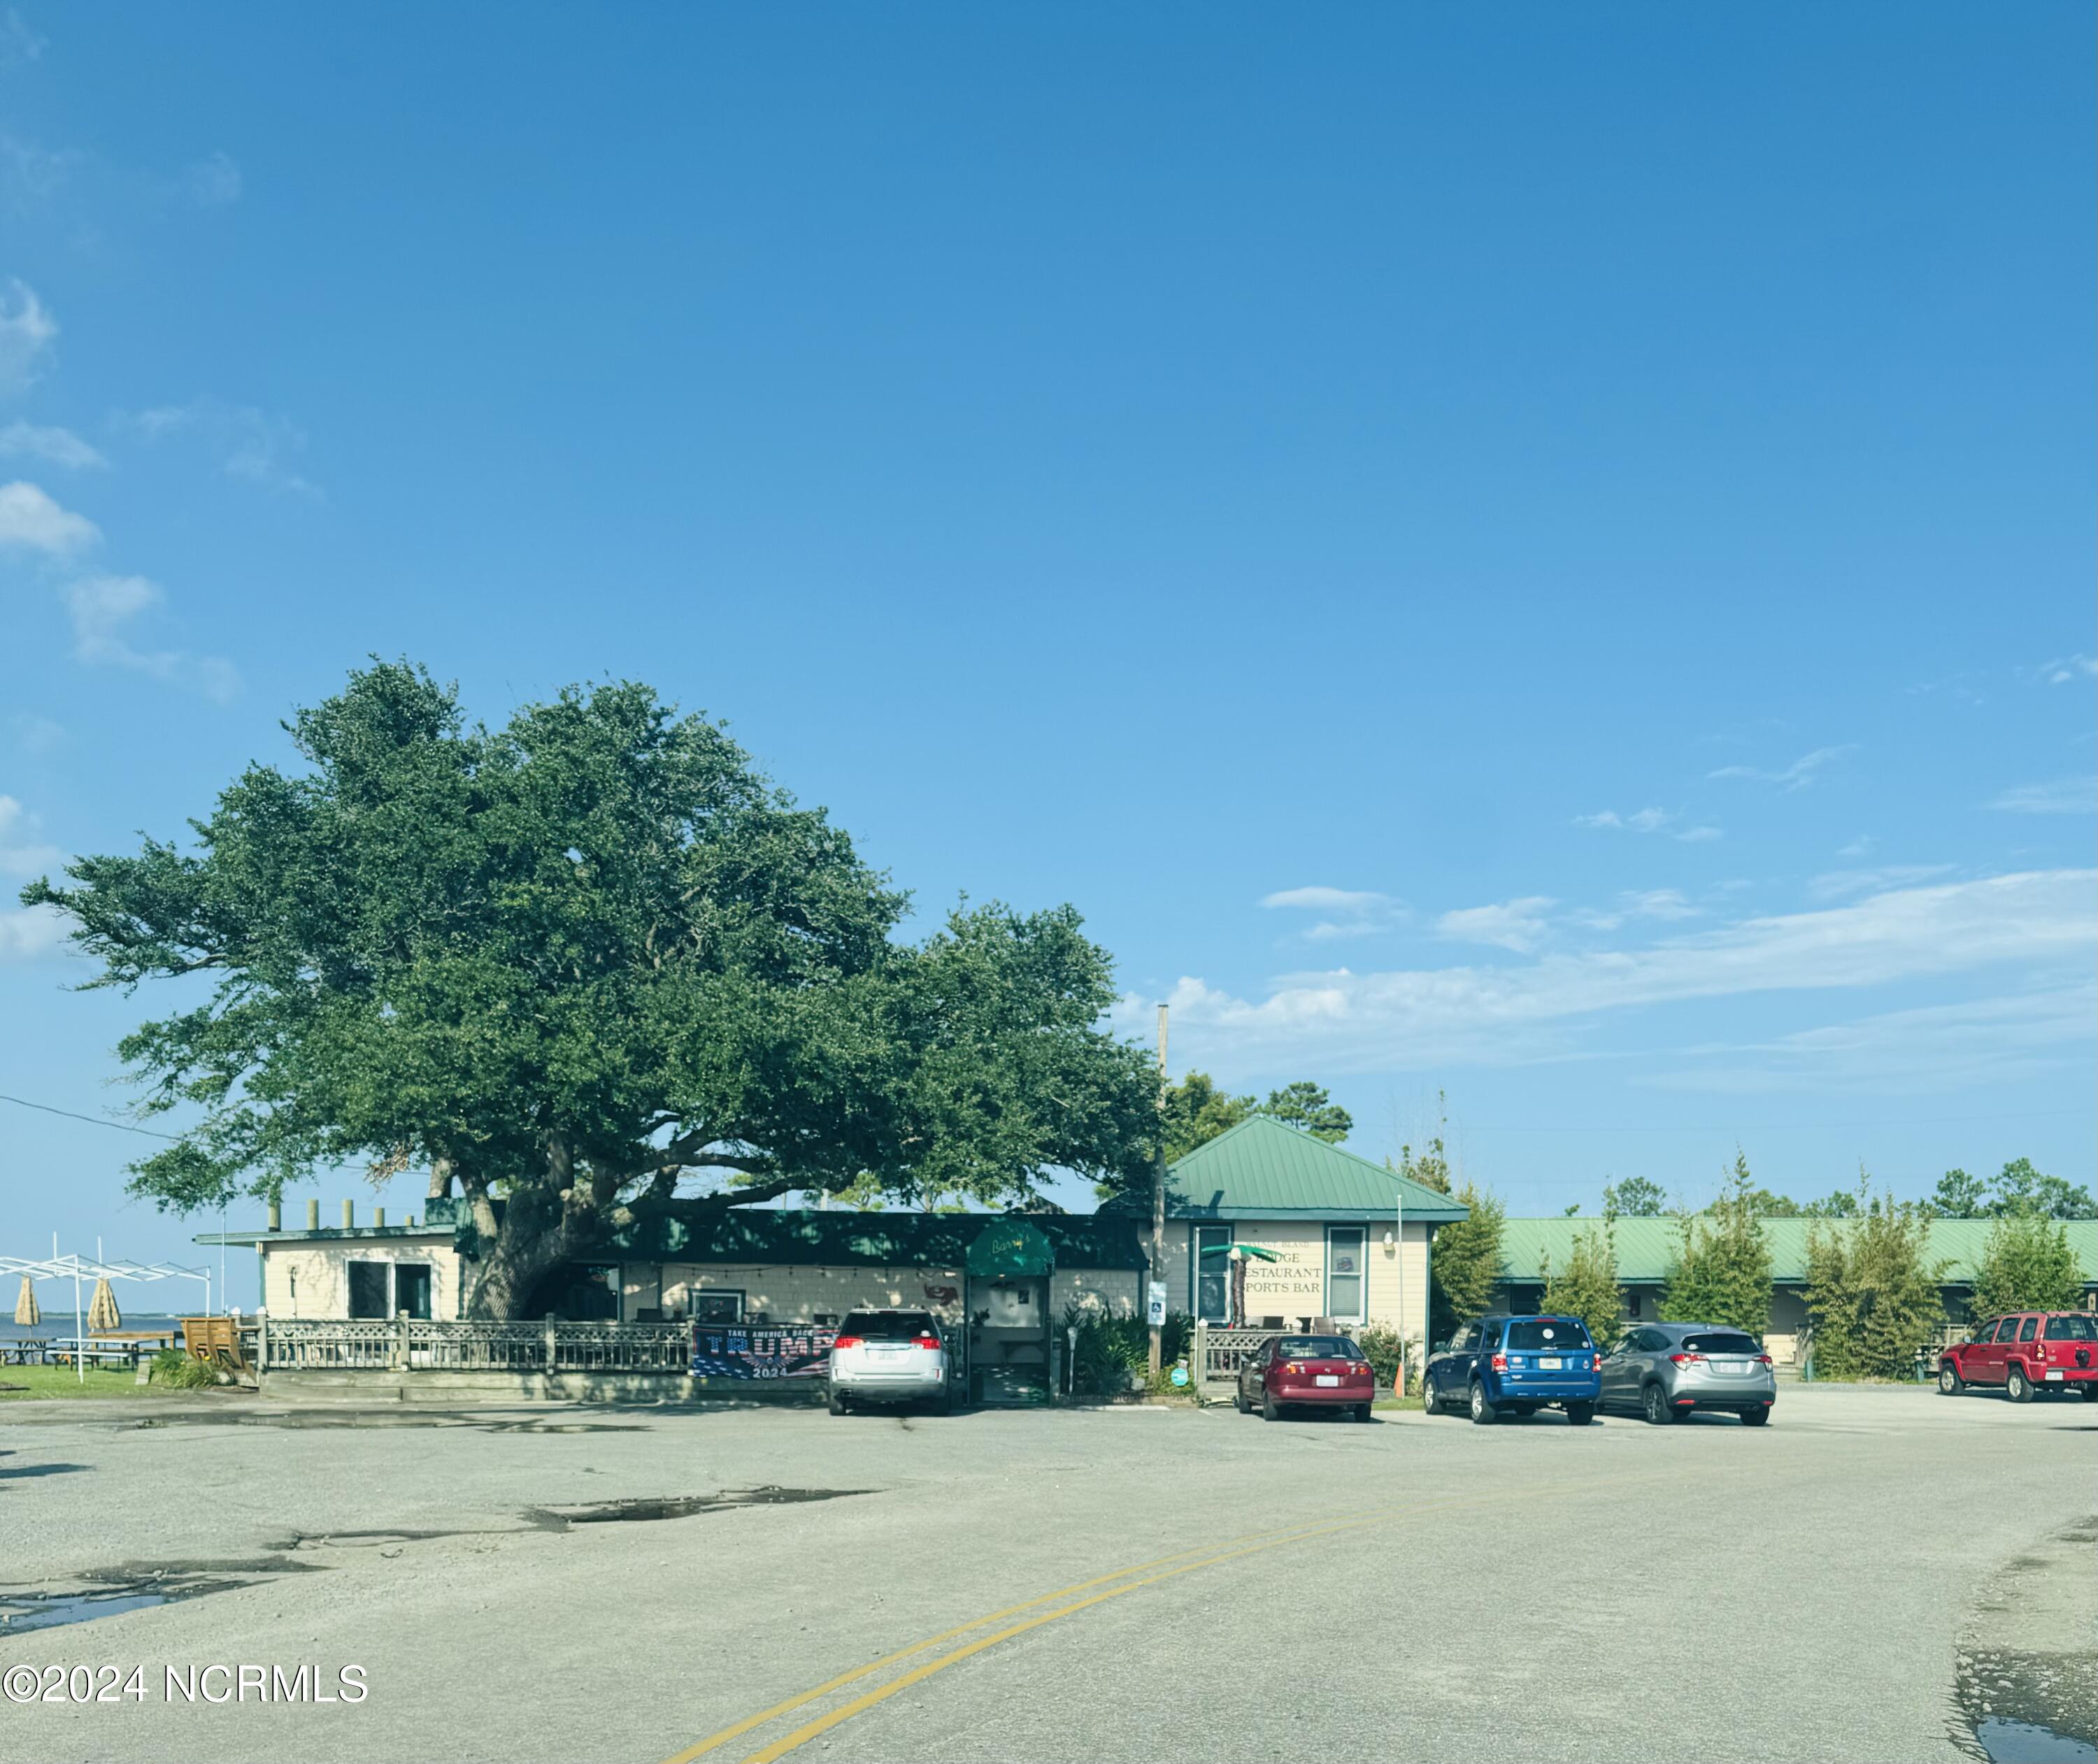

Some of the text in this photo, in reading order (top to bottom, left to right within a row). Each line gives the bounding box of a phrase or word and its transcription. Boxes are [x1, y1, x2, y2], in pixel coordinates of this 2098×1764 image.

[1245, 1268, 1322, 1277] ESTAURANT
[1244, 1282, 1320, 1293] PORTS BAR
[752, 1330, 787, 1338] AMERICA
[706, 1336, 835, 1356] TRUMP
[752, 1367, 787, 1378] 2024
